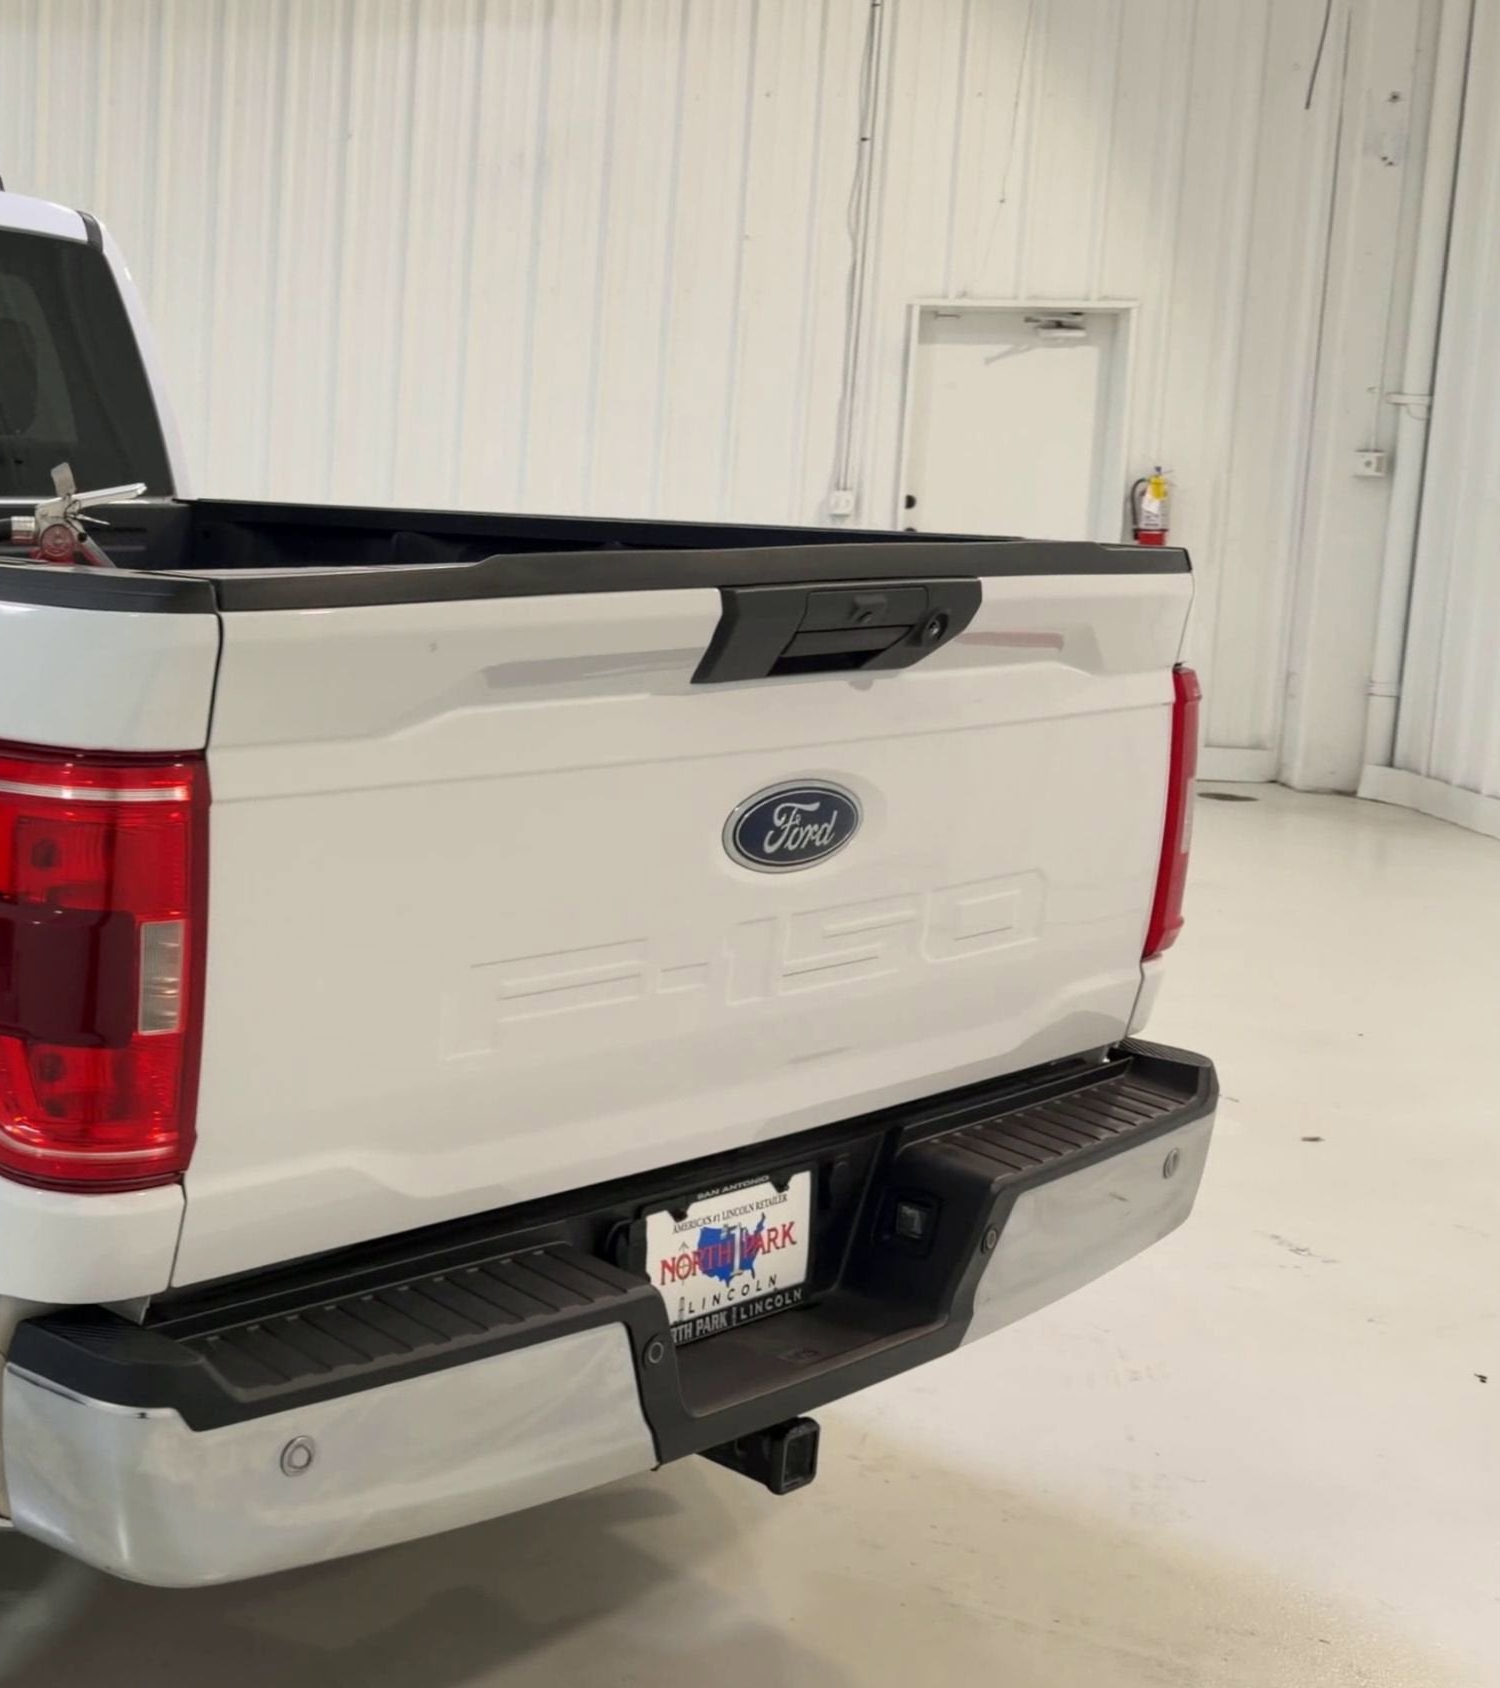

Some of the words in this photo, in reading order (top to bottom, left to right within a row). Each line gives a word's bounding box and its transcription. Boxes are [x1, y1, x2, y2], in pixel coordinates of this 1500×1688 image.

[763, 801, 838, 854] Ford
[441, 867, 1048, 1060] F-150
[697, 1188, 720, 1200] SAN
[722, 1174, 770, 1193] ANTONIO
[721, 1202, 755, 1221] LINCOLN
[755, 1193, 789, 1211] RETAILER
[660, 1240, 732, 1286] NORTH
[743, 1220, 798, 1260] PARK
[688, 1273, 778, 1315] LINCOLN
[695, 1309, 728, 1337] PARK
[740, 1288, 803, 1320] LINCOLN
